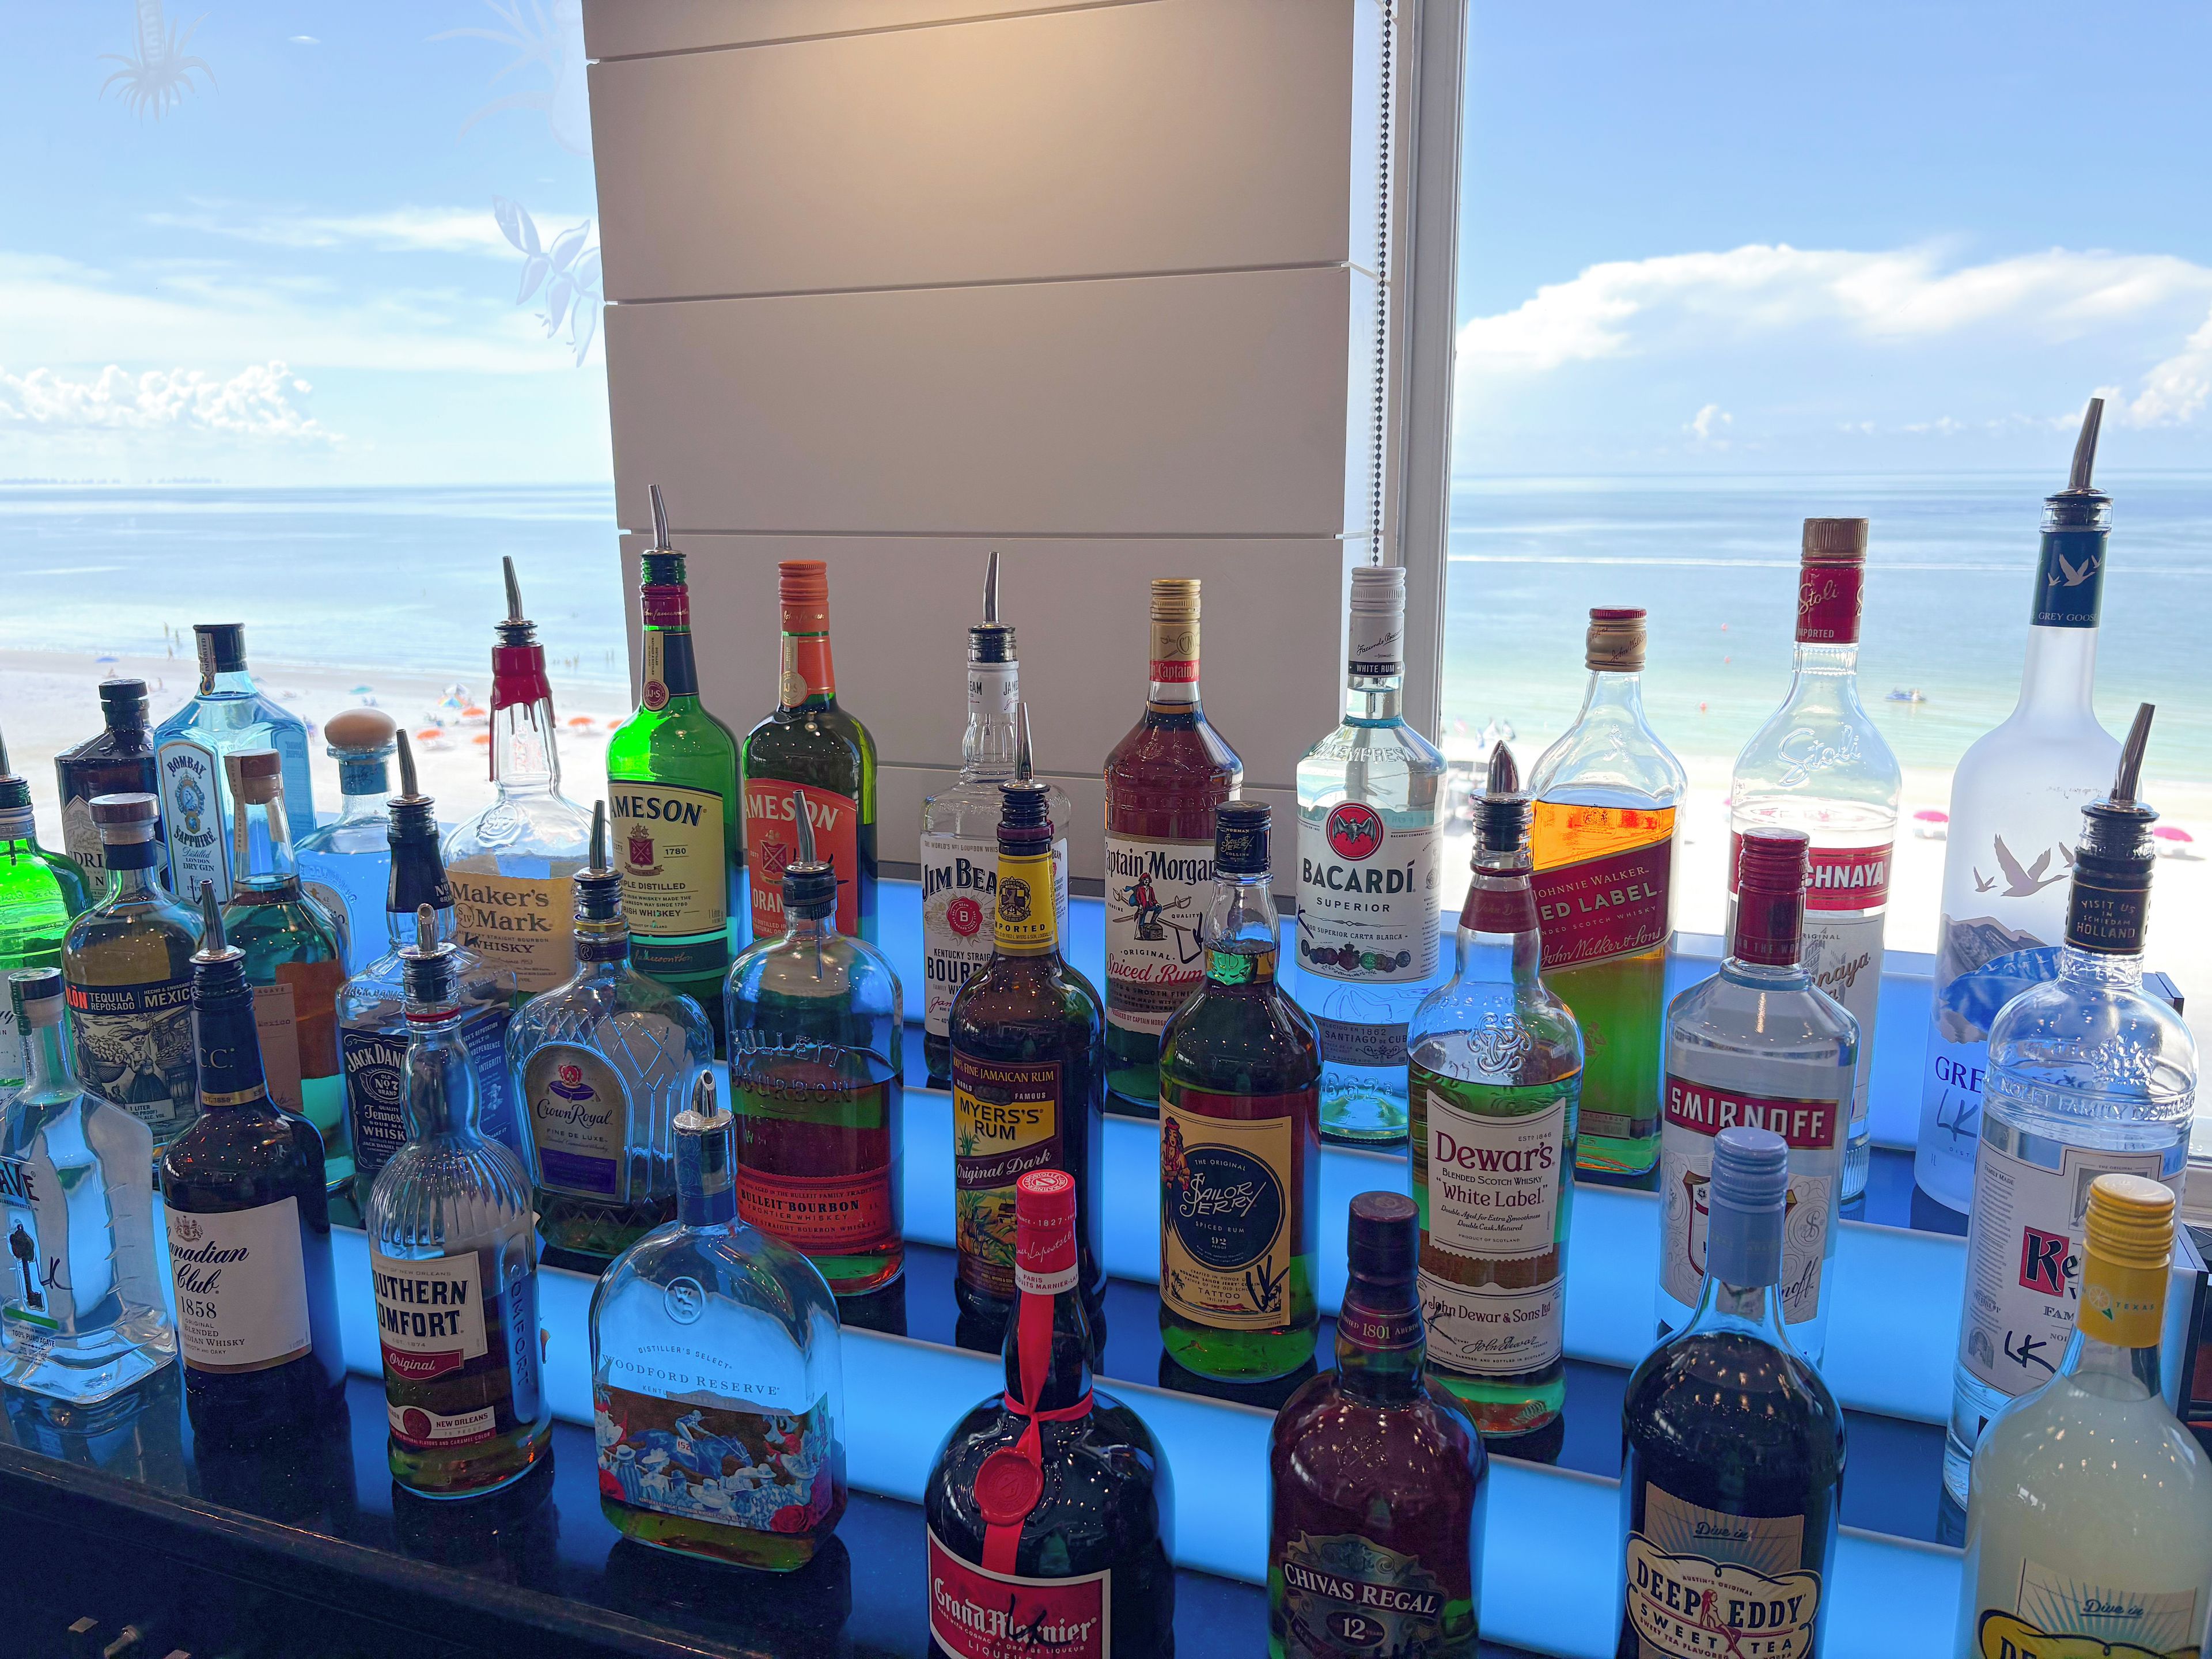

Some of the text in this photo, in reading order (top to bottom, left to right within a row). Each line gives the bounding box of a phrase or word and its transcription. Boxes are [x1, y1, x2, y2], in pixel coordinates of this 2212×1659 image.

[1798, 579, 1839, 615] Stoli
[2039, 612, 2098, 622] GREY GOOSE
[1158, 664, 1192, 680] Captain
[1357, 664, 1395, 673] WHITE RUM
[166, 755, 207, 779] BOMBAY
[611, 796, 703, 827] AMESON
[746, 794, 839, 831] AMESON
[173, 825, 216, 847] SAPPHIRE
[182, 847, 212, 858] Distilled
[923, 858, 997, 902] JIM BEA
[1303, 858, 1415, 894] BACARDÍ
[1532, 866, 1645, 902] JOHNNIE WALKER
[450, 881, 549, 907] Maker's
[1316, 897, 1390, 912] SUPERIOR
[1579, 882, 1657, 913] LABEL
[1573, 905, 1657, 929] SCOTCH WHISKY
[2081, 900, 2136, 914] VISIT US
[476, 908, 552, 932] Mark
[2077, 922, 2135, 938] HOLLAND
[2084, 915, 2131, 925] SCHIEDAM
[1317, 926, 1348, 938] SUPERIOR
[1350, 931, 1373, 940] CARTA
[934, 948, 964, 959] KENTUCKY
[1541, 925, 1661, 969] John Walker Sons
[1107, 953, 1204, 987] Spiced Rum
[89, 993, 134, 1003] TEQUILA
[91, 1002, 135, 1011] REPOSADO
[1325, 1031, 1376, 1044] SANTIAGO
[346, 1047, 375, 1073] JACK
[964, 1062, 1054, 1082] FINE JAMAICAN RUM
[1935, 1056, 1984, 1094] GRE
[536, 1099, 612, 1128] Crown Royal
[960, 1097, 1039, 1124] MYERS'S
[1671, 1086, 1824, 1139] SMIRNOFF
[2058, 1096, 2127, 1120] FAMILY
[547, 1128, 605, 1143] FINE LUXE
[975, 1120, 1016, 1141] RUM
[1435, 1130, 1553, 1173] Dewar's
[956, 1149, 1052, 1185] Original Dark
[1210, 1159, 1246, 1171] ORIGINAL
[1442, 1168, 1542, 1185] BLENDED SCOTCH WHISKY
[1999, 1173, 2014, 1185] MADE
[1183, 1172, 1253, 1204] SAILOR
[741, 1188, 859, 1213] BULLEIT BOURBON
[1180, 1181, 1266, 1217] JERRY
[748, 1204, 791, 1219] FRONTIER
[1039, 1218, 1062, 1226] 1827
[1441, 1205, 1460, 1216] Double
[1506, 1214, 1540, 1223] Smoothness
[761, 1220, 794, 1231] STRAIGHT
[840, 1221, 876, 1231] WHISKEY
[1195, 1221, 1222, 1231] SPICED
[1457, 1219, 1479, 1229] Double
[167, 1228, 249, 1263] anadian
[1211, 1236, 1226, 1245] 92
[173, 1260, 222, 1294] Club
[373, 1270, 468, 1305] OUTHERN
[1023, 1274, 1043, 1283] PARIS
[1198, 1287, 1240, 1299] TATTOO
[181, 1296, 217, 1319] 1858
[1428, 1296, 1540, 1323] John Dewar Sons
[2116, 1301, 2155, 1310] TEXAS
[185, 1319, 214, 1328] ORIGINAL
[378, 1302, 461, 1337] OMFORT
[185, 1324, 218, 1337] BLENDED
[1362, 1323, 1391, 1339] 1801
[206, 1339, 245, 1347] WHISKY
[389, 1353, 435, 1372] Original
[638, 1346, 729, 1369] DISTILLER'S SELECT
[602, 1354, 777, 1395] WOODFORD RESERVE
[454, 1413, 488, 1426] ORLEANS
[1695, 1522, 1730, 1536] Dive
[1284, 1563, 1436, 1613] CHIVAS REGAL
[1637, 1556, 1803, 1629] DEEP EDDY
[1682, 1575, 1753, 1596] AUSTIN'S ORIGINAL
[934, 1577, 1092, 1645] Grand Marnier
[2084, 1599, 2124, 1613] Dive
[965, 1628, 991, 1644] COGNAC
[1343, 1618, 1366, 1640] 12
[1640, 1618, 1679, 1646] SWEET TEA
[1641, 1603, 1792, 1653] SWEET TEA
